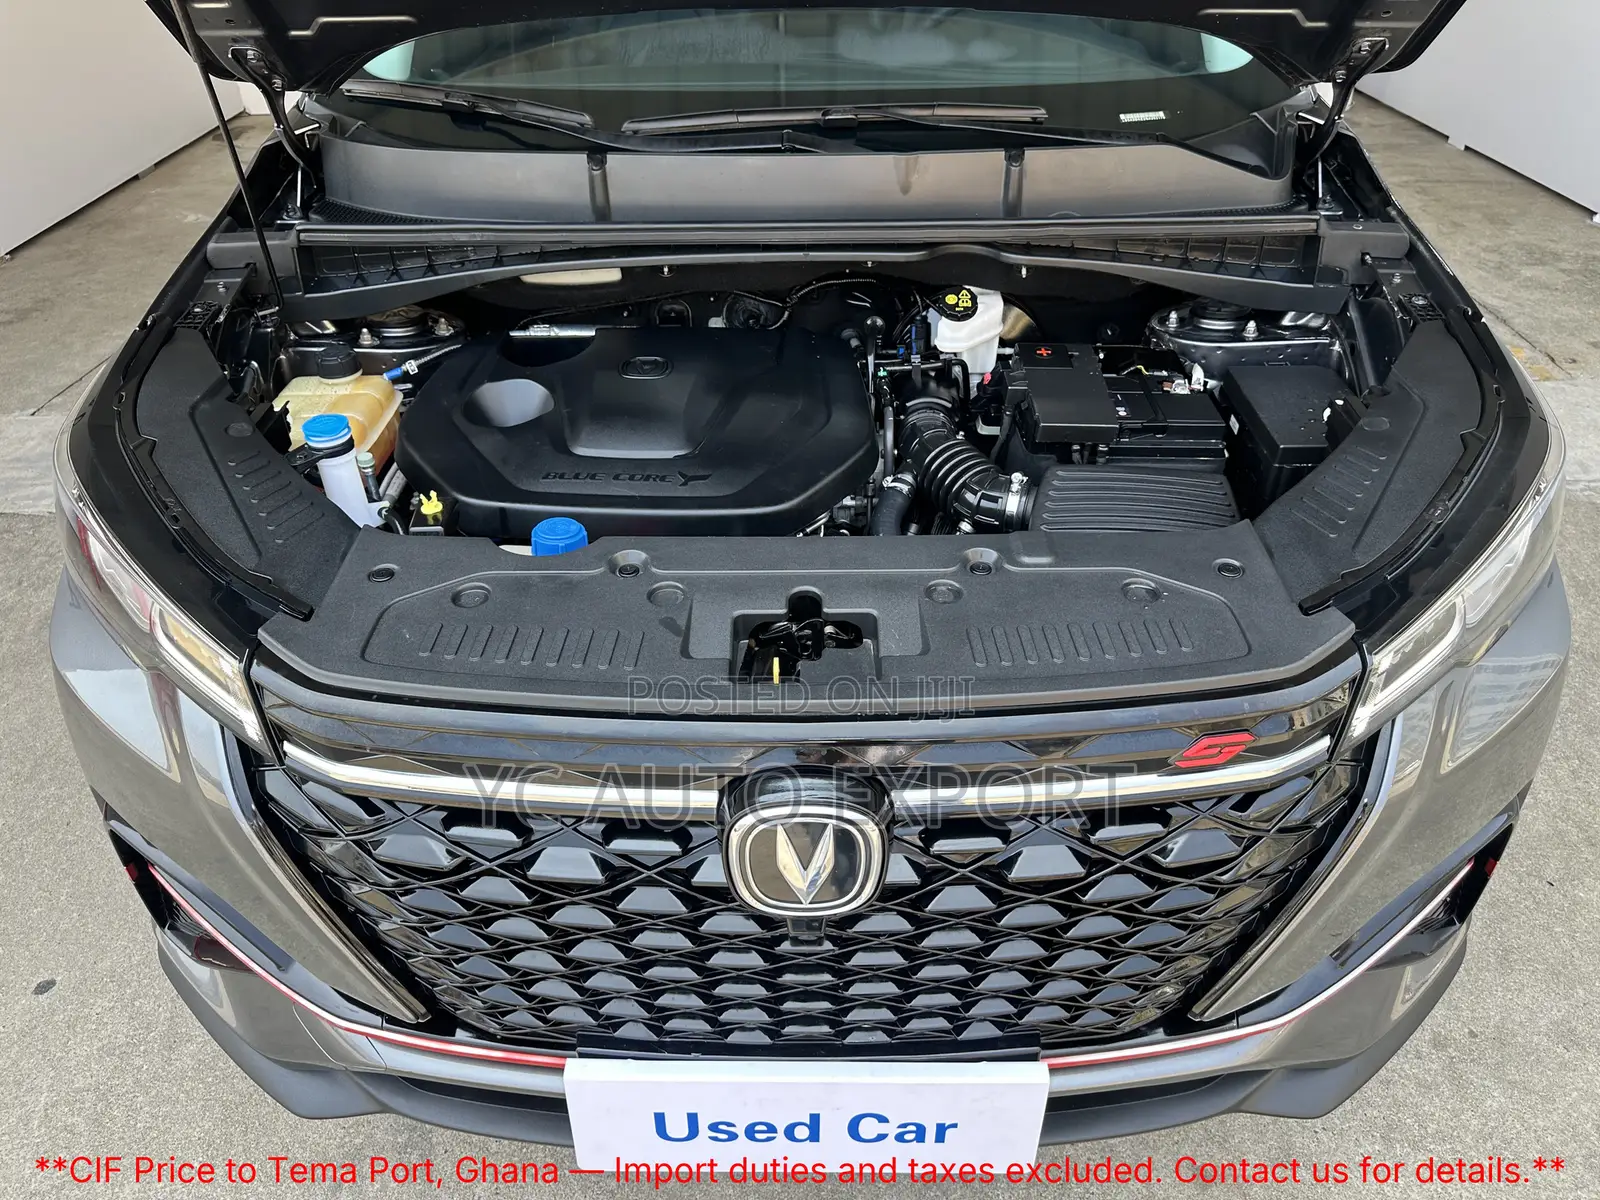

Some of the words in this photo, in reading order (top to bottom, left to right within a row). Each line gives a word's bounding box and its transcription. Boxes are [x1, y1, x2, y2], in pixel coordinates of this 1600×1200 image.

[541, 472, 606, 482] BLUE
[612, 472, 677, 483] CORE
[653, 1112, 821, 1144] Used
[847, 1112, 959, 1145] Car
